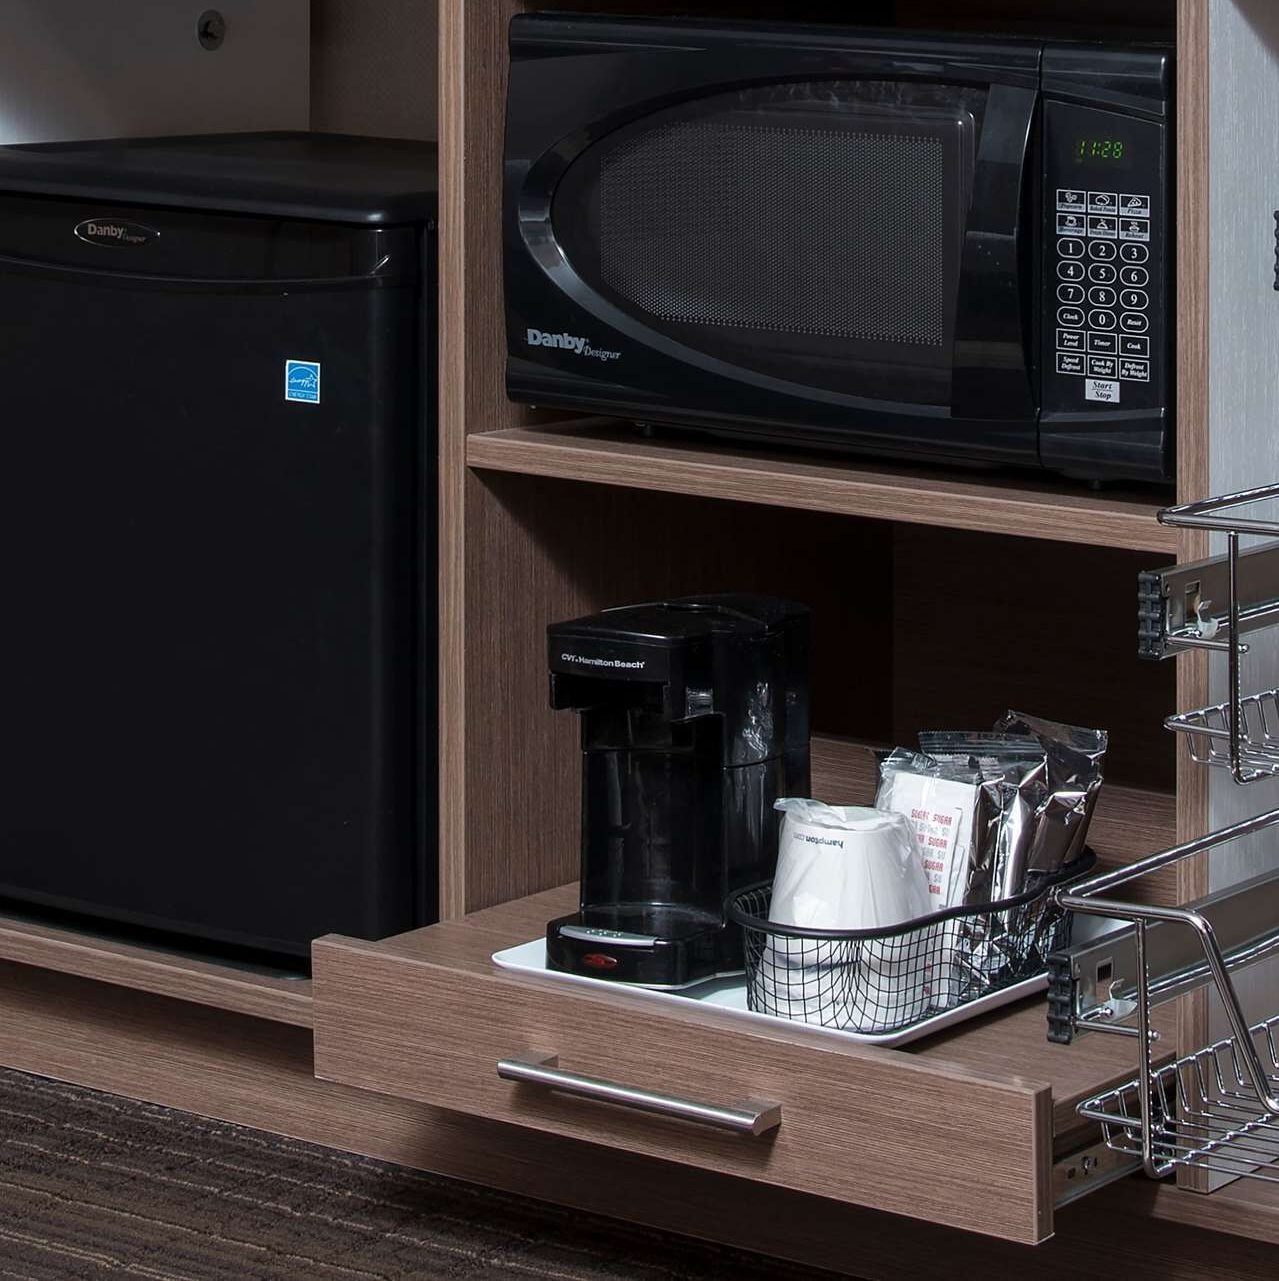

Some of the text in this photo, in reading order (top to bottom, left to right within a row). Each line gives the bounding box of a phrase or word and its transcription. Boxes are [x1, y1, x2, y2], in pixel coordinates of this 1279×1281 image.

[1080, 141, 1123, 159] 11:28
[87, 223, 124, 239] Danby
[1099, 245, 1106, 256] 2
[1130, 247, 1138, 259] 3
[1067, 265, 1074, 277] 4
[1099, 268, 1106, 279] 5
[1130, 270, 1138, 282] 6
[1067, 288, 1074, 299] 7
[1099, 290, 1106, 302] 8
[1130, 293, 1138, 305] 9
[1099, 313, 1106, 325] 0
[527, 328, 621, 361] Danby Designer
[1094, 339, 1111, 347] Timer
[1127, 342, 1141, 350] Cook
[1106, 360, 1114, 368] By
[1093, 380, 1112, 389] Start
[1095, 391, 1112, 400] Stop
[578, 656, 614, 667] Hamilton
[805, 835, 843, 849] hampton
